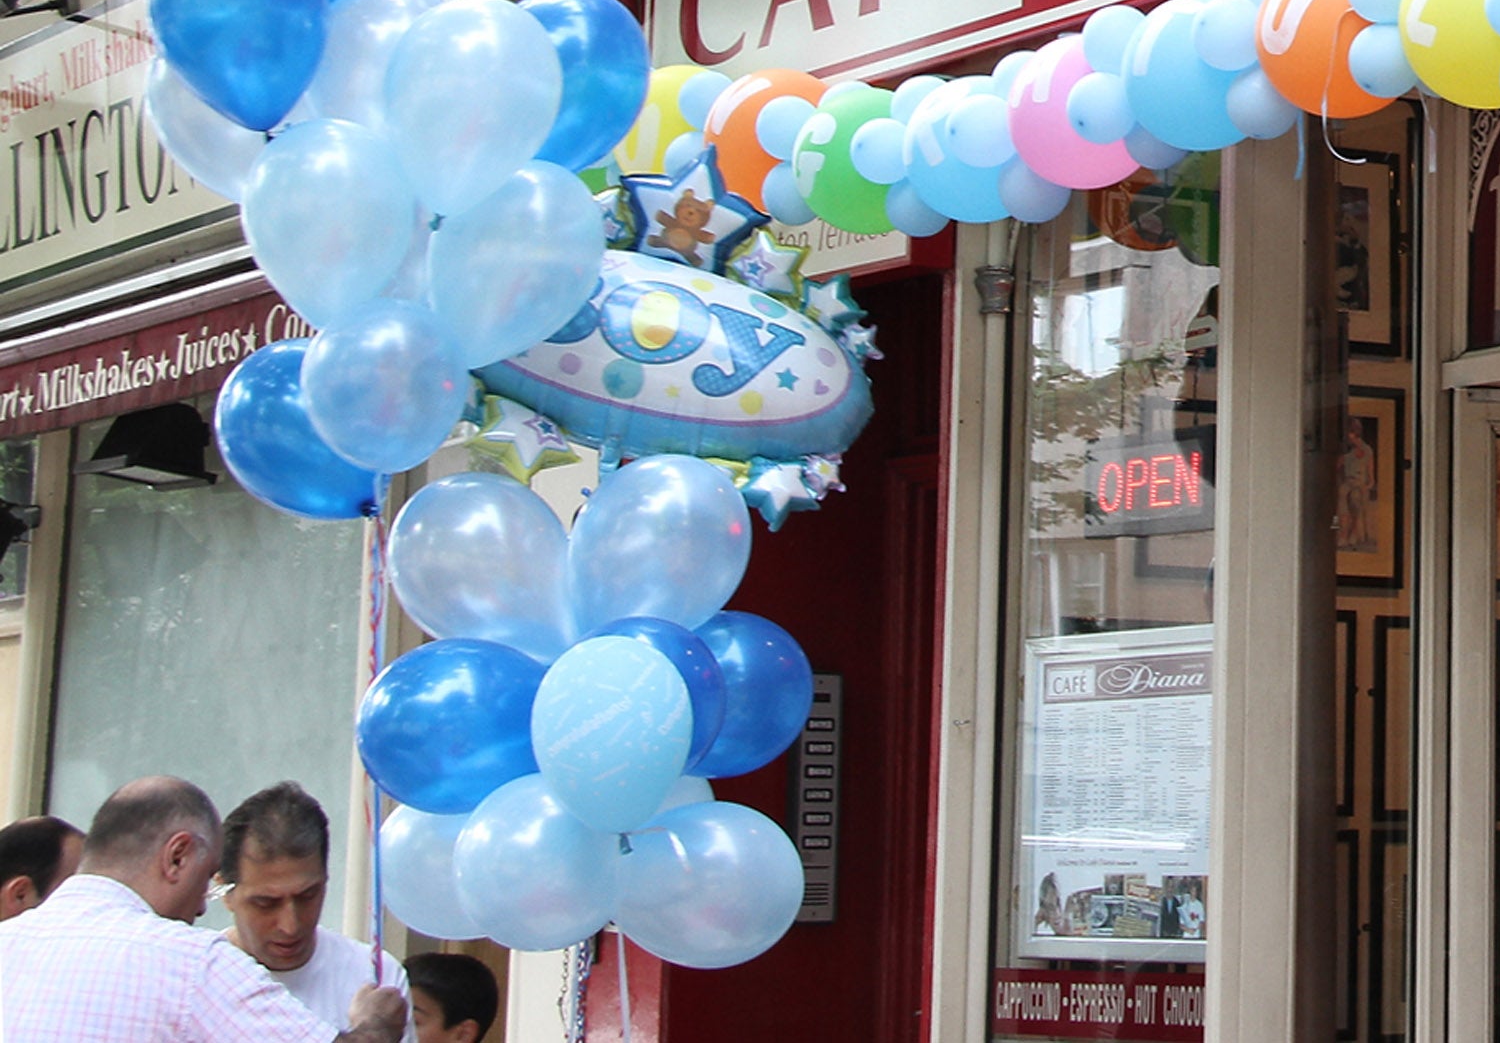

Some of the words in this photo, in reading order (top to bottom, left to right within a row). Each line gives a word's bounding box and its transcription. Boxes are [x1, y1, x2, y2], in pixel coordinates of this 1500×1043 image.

[33, 349, 155, 414] Milkshakes
[170, 326, 241, 380] Juices
[1097, 451, 1201, 513] OPEN
[1097, 663, 1206, 695] Diana
[996, 981, 1062, 1022] CAPPUCCINO
[1069, 983, 1126, 1024] ESPRESSO
[1135, 985, 1158, 1025] HOT
